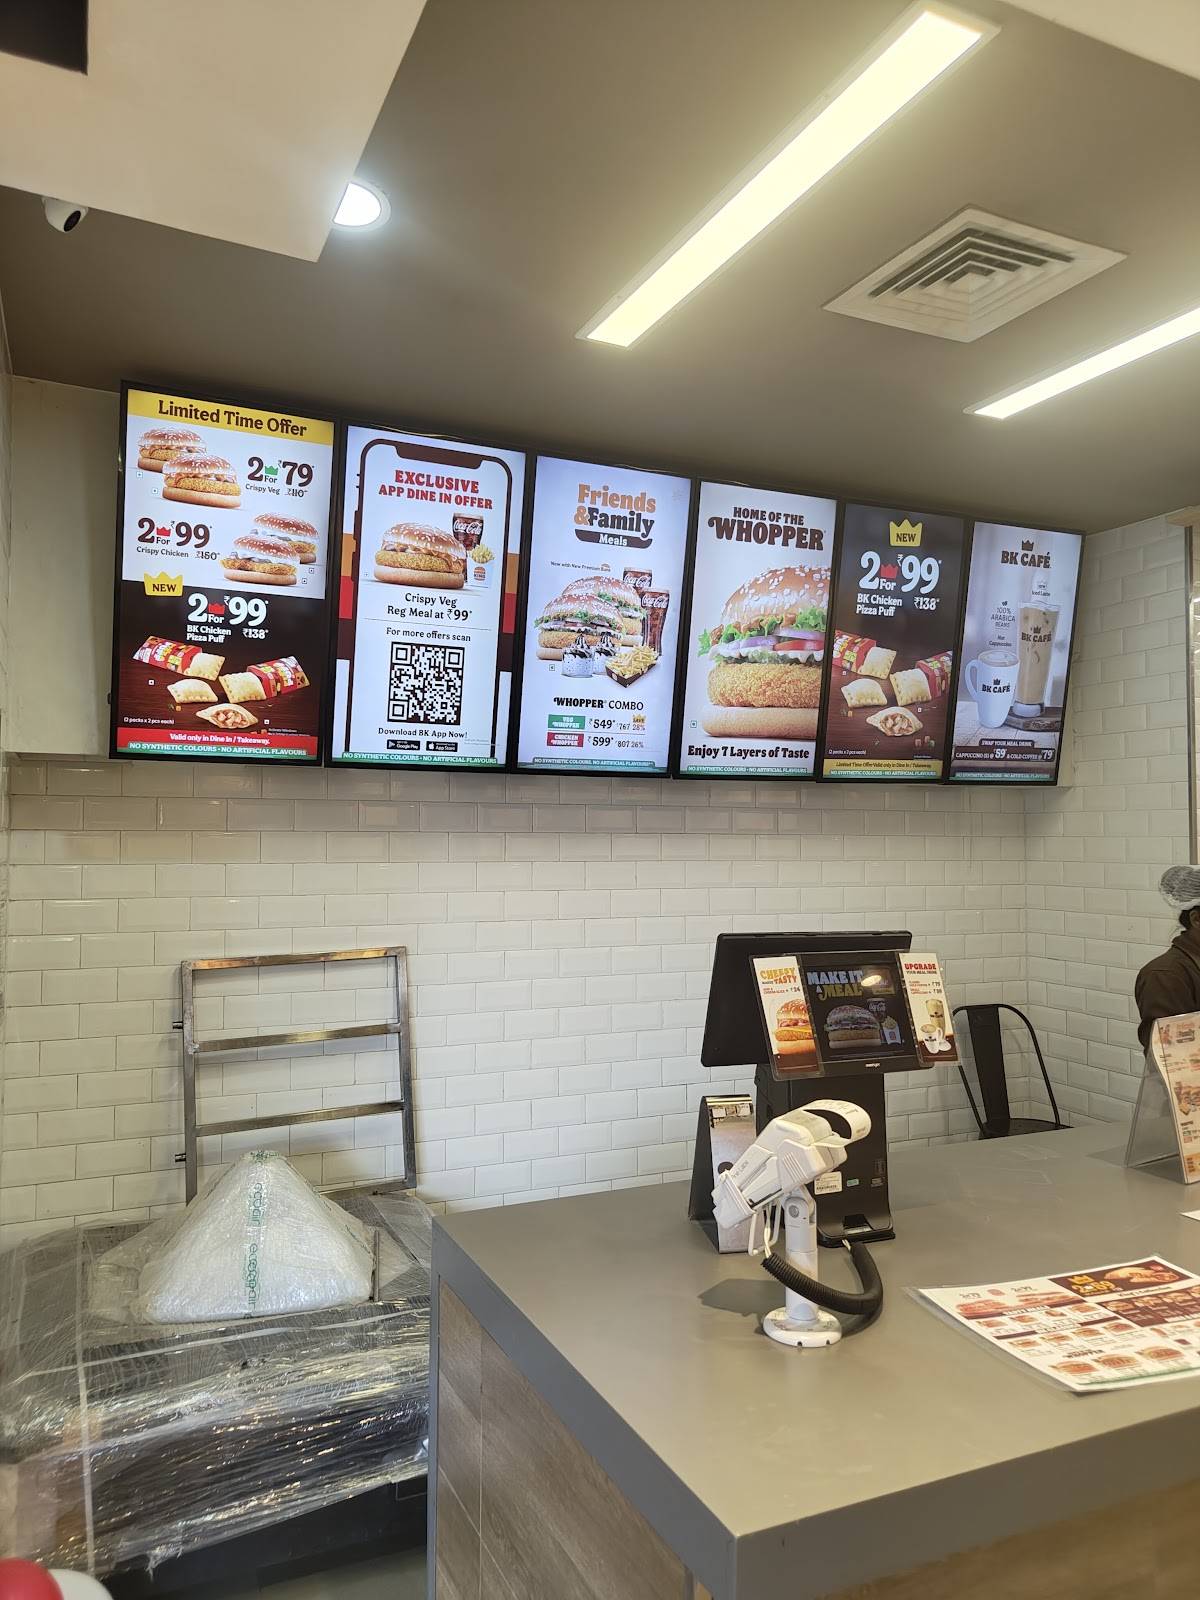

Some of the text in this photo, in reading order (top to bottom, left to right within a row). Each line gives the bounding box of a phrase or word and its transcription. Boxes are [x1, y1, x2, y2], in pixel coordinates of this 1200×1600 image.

[158, 400, 308, 437] Limited Time Offer
[248, 456, 264, 481] 2
[265, 475, 278, 484] For
[395, 470, 479, 494] EXCLUSIVE
[245, 483, 266, 493] Crispy
[268, 486, 280, 495] Veg
[378, 484, 493, 510] APP DINE IN OFFER
[578, 483, 656, 513] Friends
[574, 506, 655, 538] &Family
[733, 507, 804, 525] HOME OF THE
[138, 517, 155, 543] 2
[156, 537, 170, 545] For
[708, 517, 824, 550] WHOPPER
[896, 533, 916, 542] NEW
[599, 534, 627, 546] Meals
[136, 546, 159, 556] Crispy
[161, 549, 189, 558] Chicken
[1001, 551, 1051, 568] BK CAFÉ
[859, 551, 880, 589] 2
[879, 579, 897, 590] For
[152, 584, 177, 593] NEW
[405, 593, 458, 608] Crispy Veg
[857, 593, 870, 604] BK
[871, 594, 903, 606] Chicken
[188, 593, 208, 622] 2
[208, 614, 224, 623] For
[387, 606, 406, 617] Reg
[408, 608, 433, 618] Meal
[434, 611, 444, 619] at
[856, 605, 896, 616] Pizza Puff
[186, 625, 232, 635] BK Chicken
[386, 627, 471, 642] For more offers scan
[186, 633, 226, 643] Pizza Puff
[1021, 632, 1052, 642] BK CAFÉ
[982, 684, 992, 692] BK
[554, 697, 644, 710] WHOPPER COMBO
[169, 733, 187, 741] Valid
[378, 728, 416, 736] Download
[431, 730, 446, 738] App
[688, 745, 809, 759] Enjoy 7 Layers of Taste
[760, 967, 795, 980] CHEESY
[773, 975, 797, 984] TASTY
[806, 970, 863, 984] MAKE IT
[816, 985, 822, 993] A
[818, 983, 863, 1000] MEAL
